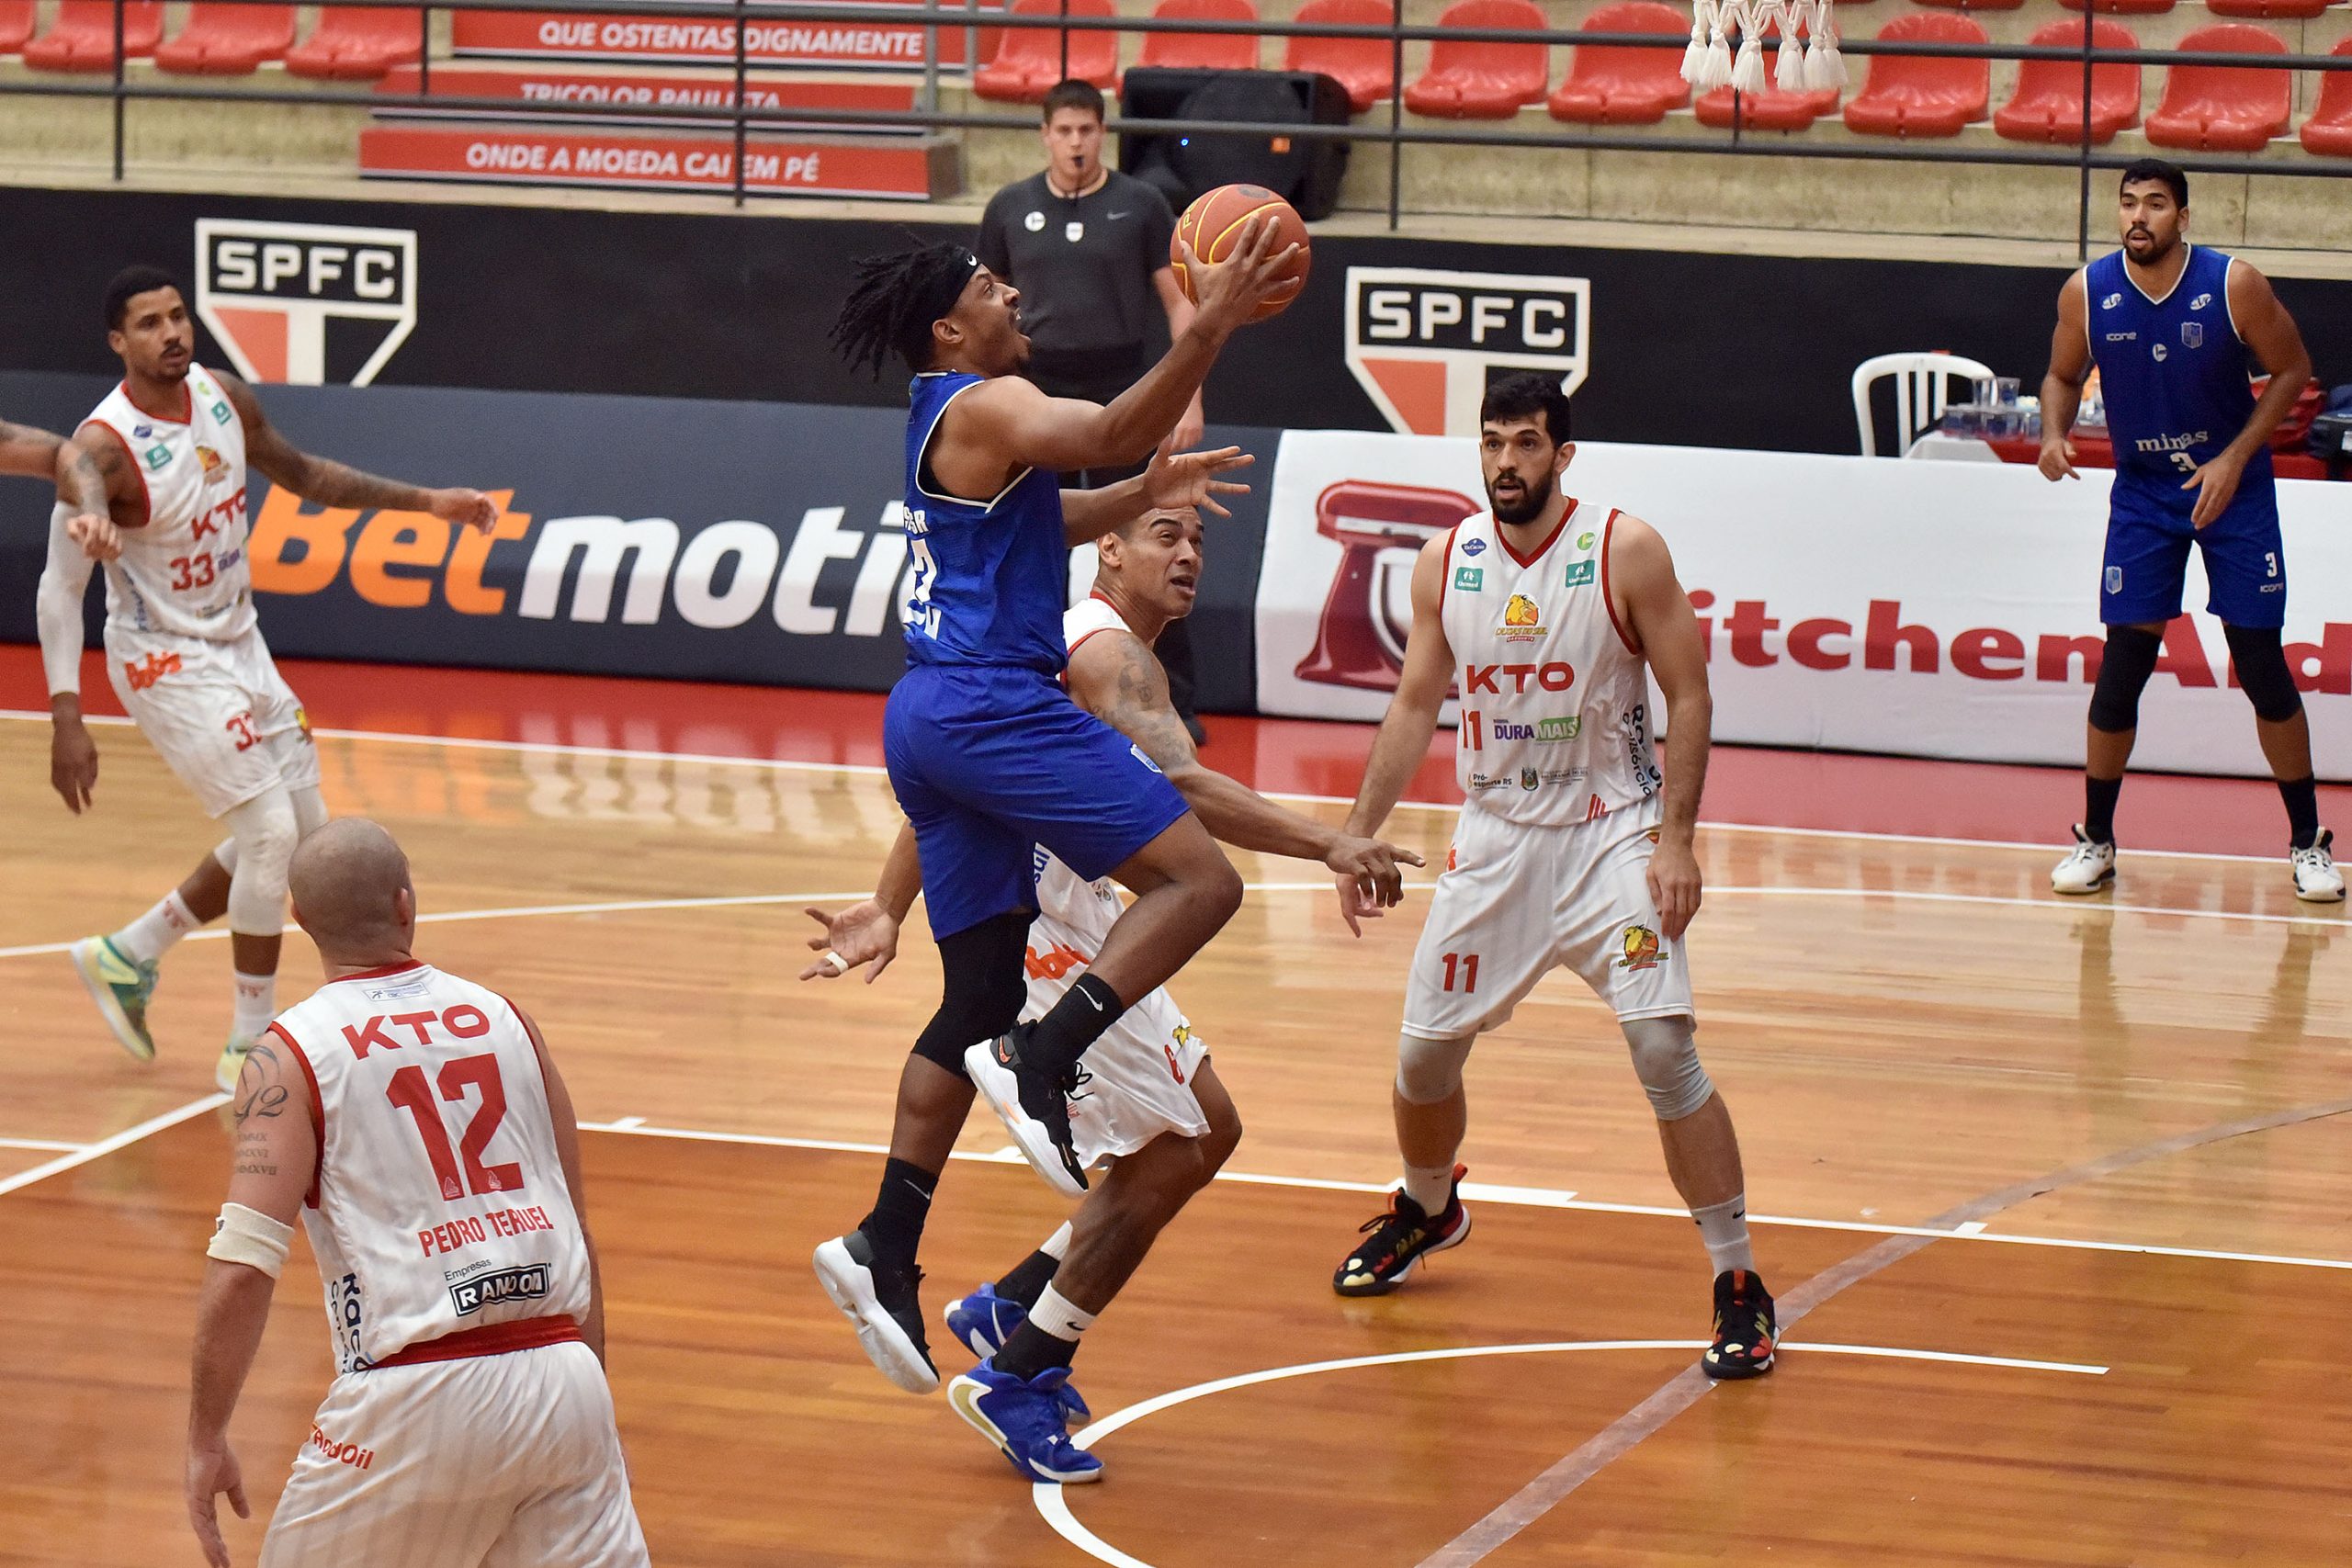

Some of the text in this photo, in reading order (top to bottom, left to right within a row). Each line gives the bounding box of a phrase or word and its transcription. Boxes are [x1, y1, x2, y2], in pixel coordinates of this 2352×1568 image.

[538, 20, 922, 55] QUE OSTENTAS DIGNAMENTE
[466, 142, 546, 170] ONDE
[548, 147, 570, 171] A
[574, 148, 678, 175] MOEDA
[684, 152, 731, 177] CAI
[784, 152, 819, 182] PÉ
[216, 241, 396, 298] SPFC
[1369, 290, 1566, 347] SPFC
[2135, 431, 2209, 452] minas
[170, 552, 214, 591] 33
[246, 487, 910, 637] Betmoti
[2265, 552, 2278, 578] 3
[1466, 661, 1575, 694] KTO
[1494, 724, 1534, 740] DURA
[1442, 952, 1480, 994] 11
[341, 1004, 491, 1060] KTO
[385, 1052, 525, 1202] 12
[418, 1214, 487, 1258] PEDRO
[444, 1257, 492, 1281] Empresas
